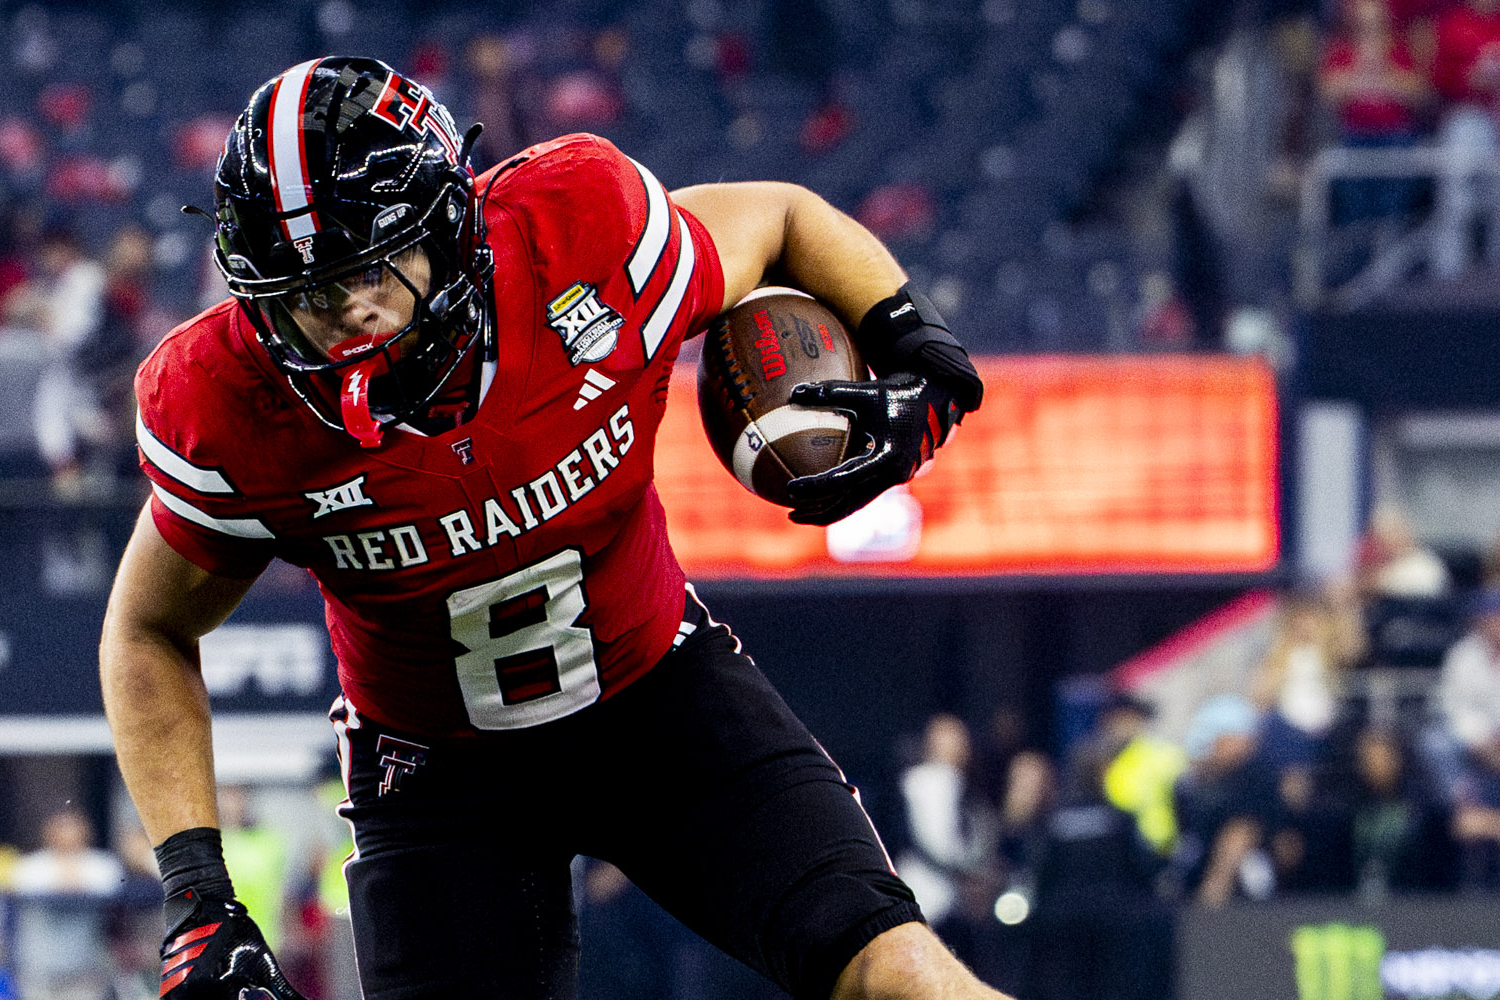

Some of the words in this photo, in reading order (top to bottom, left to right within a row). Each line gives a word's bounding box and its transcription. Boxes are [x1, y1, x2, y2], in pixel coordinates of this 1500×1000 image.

[378, 212, 397, 228] GUNS
[396, 206, 407, 218] UP
[550, 289, 611, 346] XII
[753, 309, 787, 381] Wilson
[342, 342, 374, 357] SHOCK
[304, 476, 373, 519] XII
[322, 525, 429, 570] RED
[439, 404, 635, 557] RAIDERS
[446, 549, 601, 731] 8
